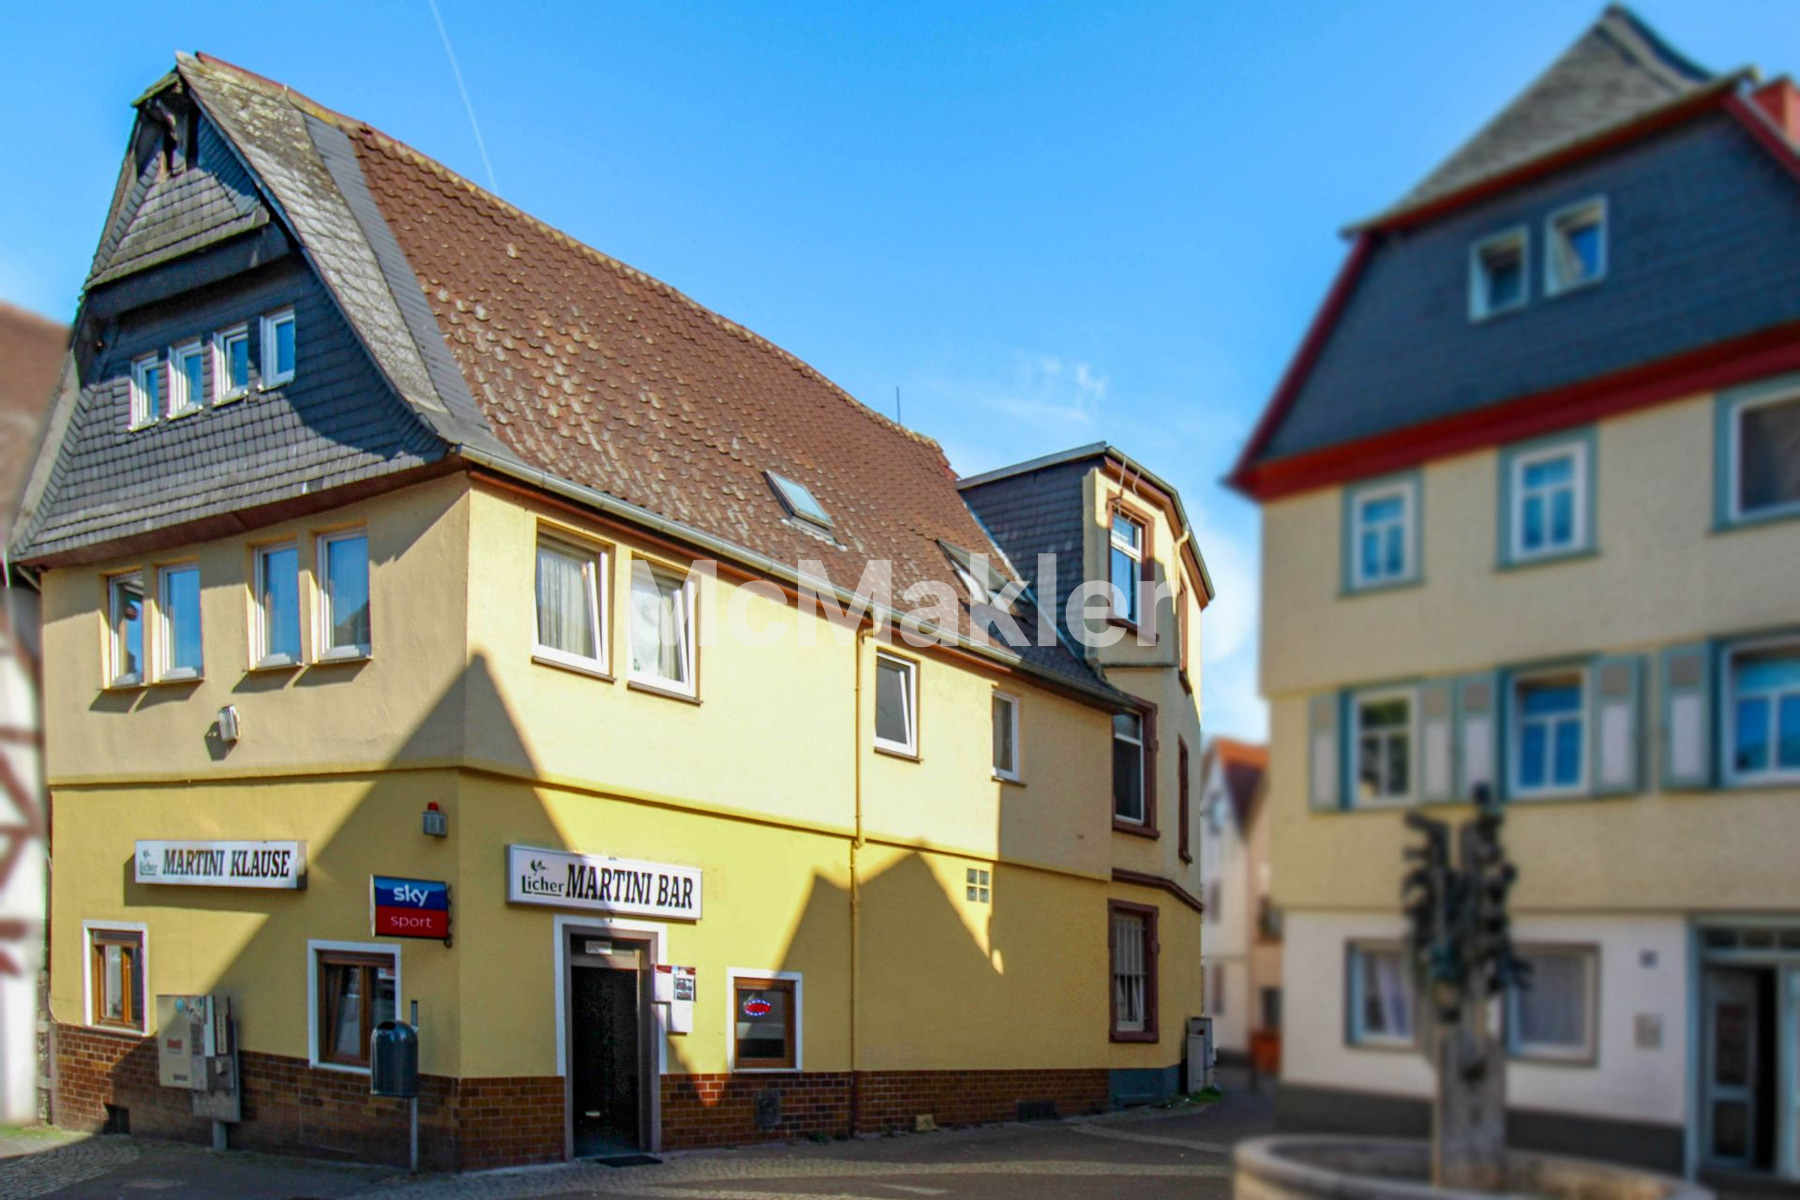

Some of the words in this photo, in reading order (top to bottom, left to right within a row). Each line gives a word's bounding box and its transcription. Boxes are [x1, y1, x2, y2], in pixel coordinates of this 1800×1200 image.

[163, 849, 225, 876] MARTINI
[230, 850, 291, 878] KLAUSE
[393, 884, 428, 907] sky
[522, 874, 564, 896] Licher
[565, 864, 652, 905] MARTINI
[656, 874, 693, 909] BAR
[390, 916, 432, 929] sport
